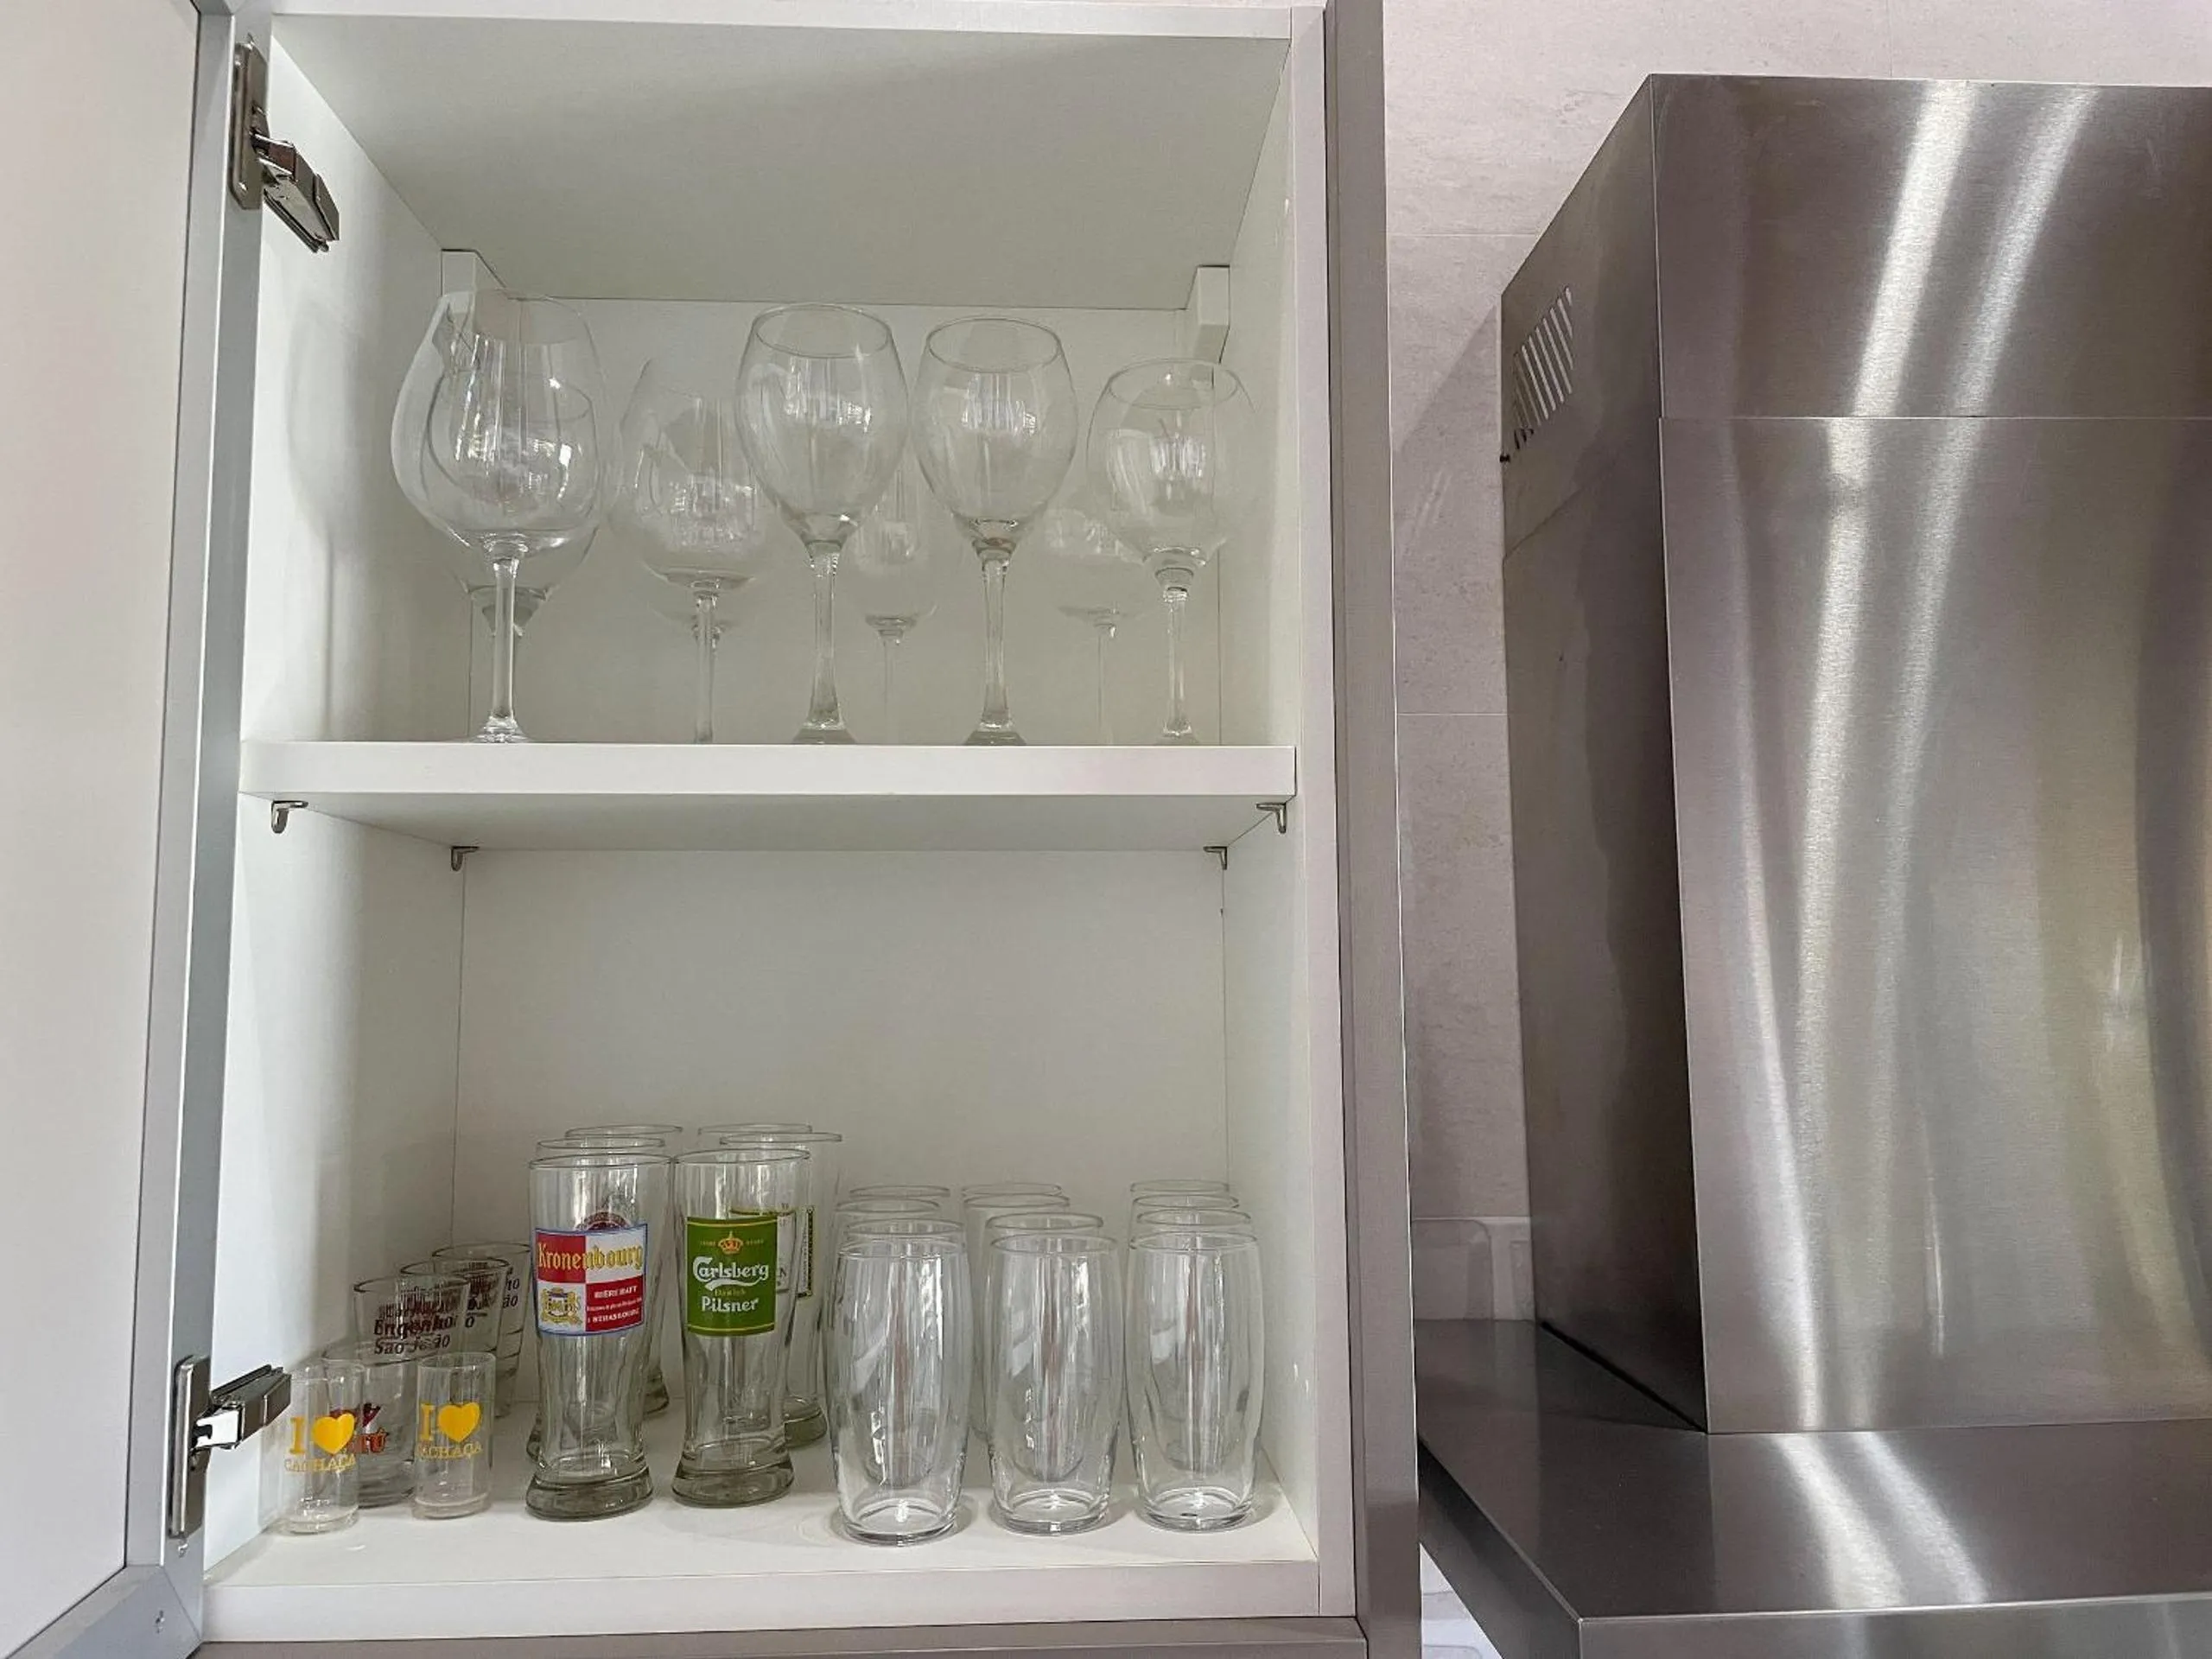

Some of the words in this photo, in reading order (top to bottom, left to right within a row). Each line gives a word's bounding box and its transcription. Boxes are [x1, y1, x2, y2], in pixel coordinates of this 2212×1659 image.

[537, 1241, 643, 1271] Kronenbourg
[692, 1255, 769, 1291] Carlsberg
[702, 1295, 760, 1313] Pilsner
